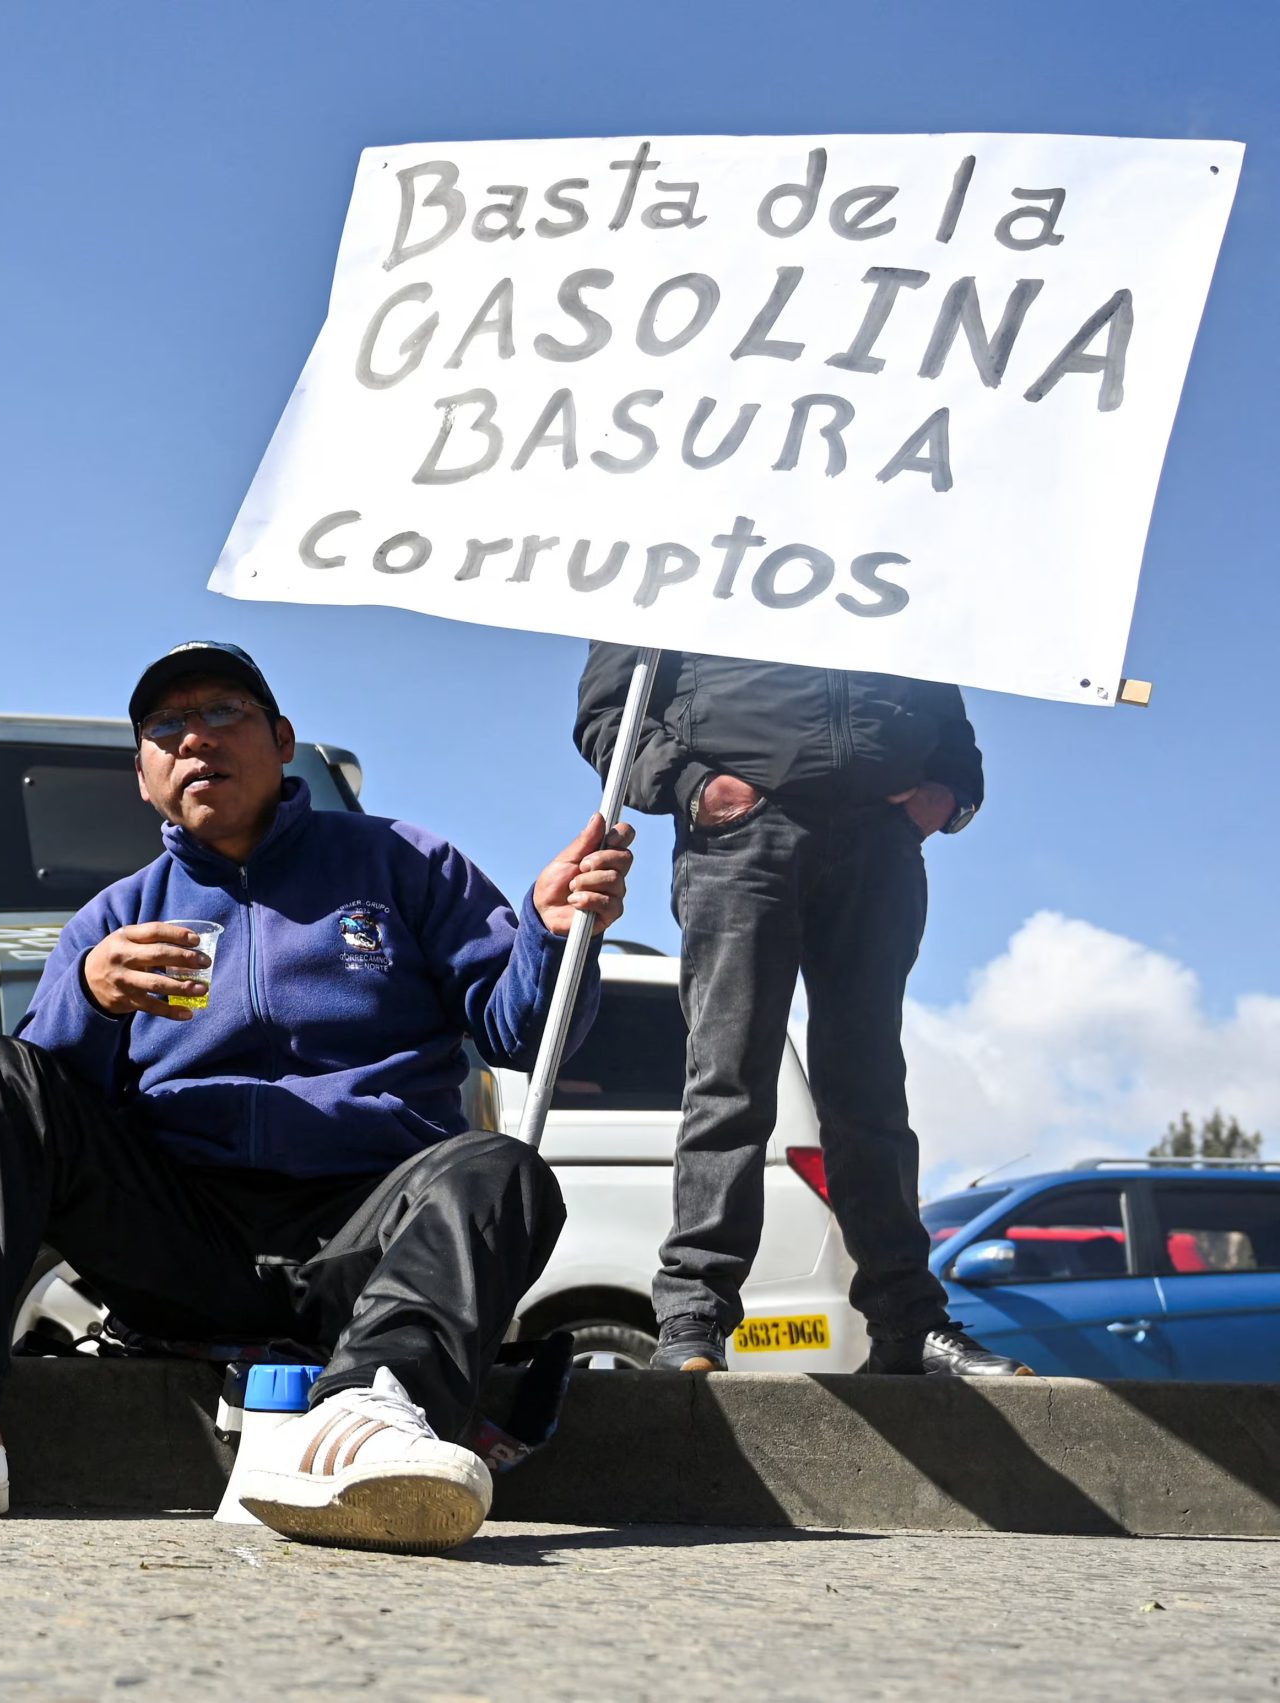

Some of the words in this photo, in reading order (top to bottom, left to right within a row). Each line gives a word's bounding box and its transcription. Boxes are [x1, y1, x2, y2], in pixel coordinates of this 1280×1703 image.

[382, 141, 707, 272] Basta
[757, 147, 899, 241] de
[936, 155, 1066, 251] la
[356, 266, 1134, 412] GASOLINA
[412, 388, 953, 492] BASURA
[366, 901, 390, 913] GRUPO
[365, 963, 388, 971] NORTE
